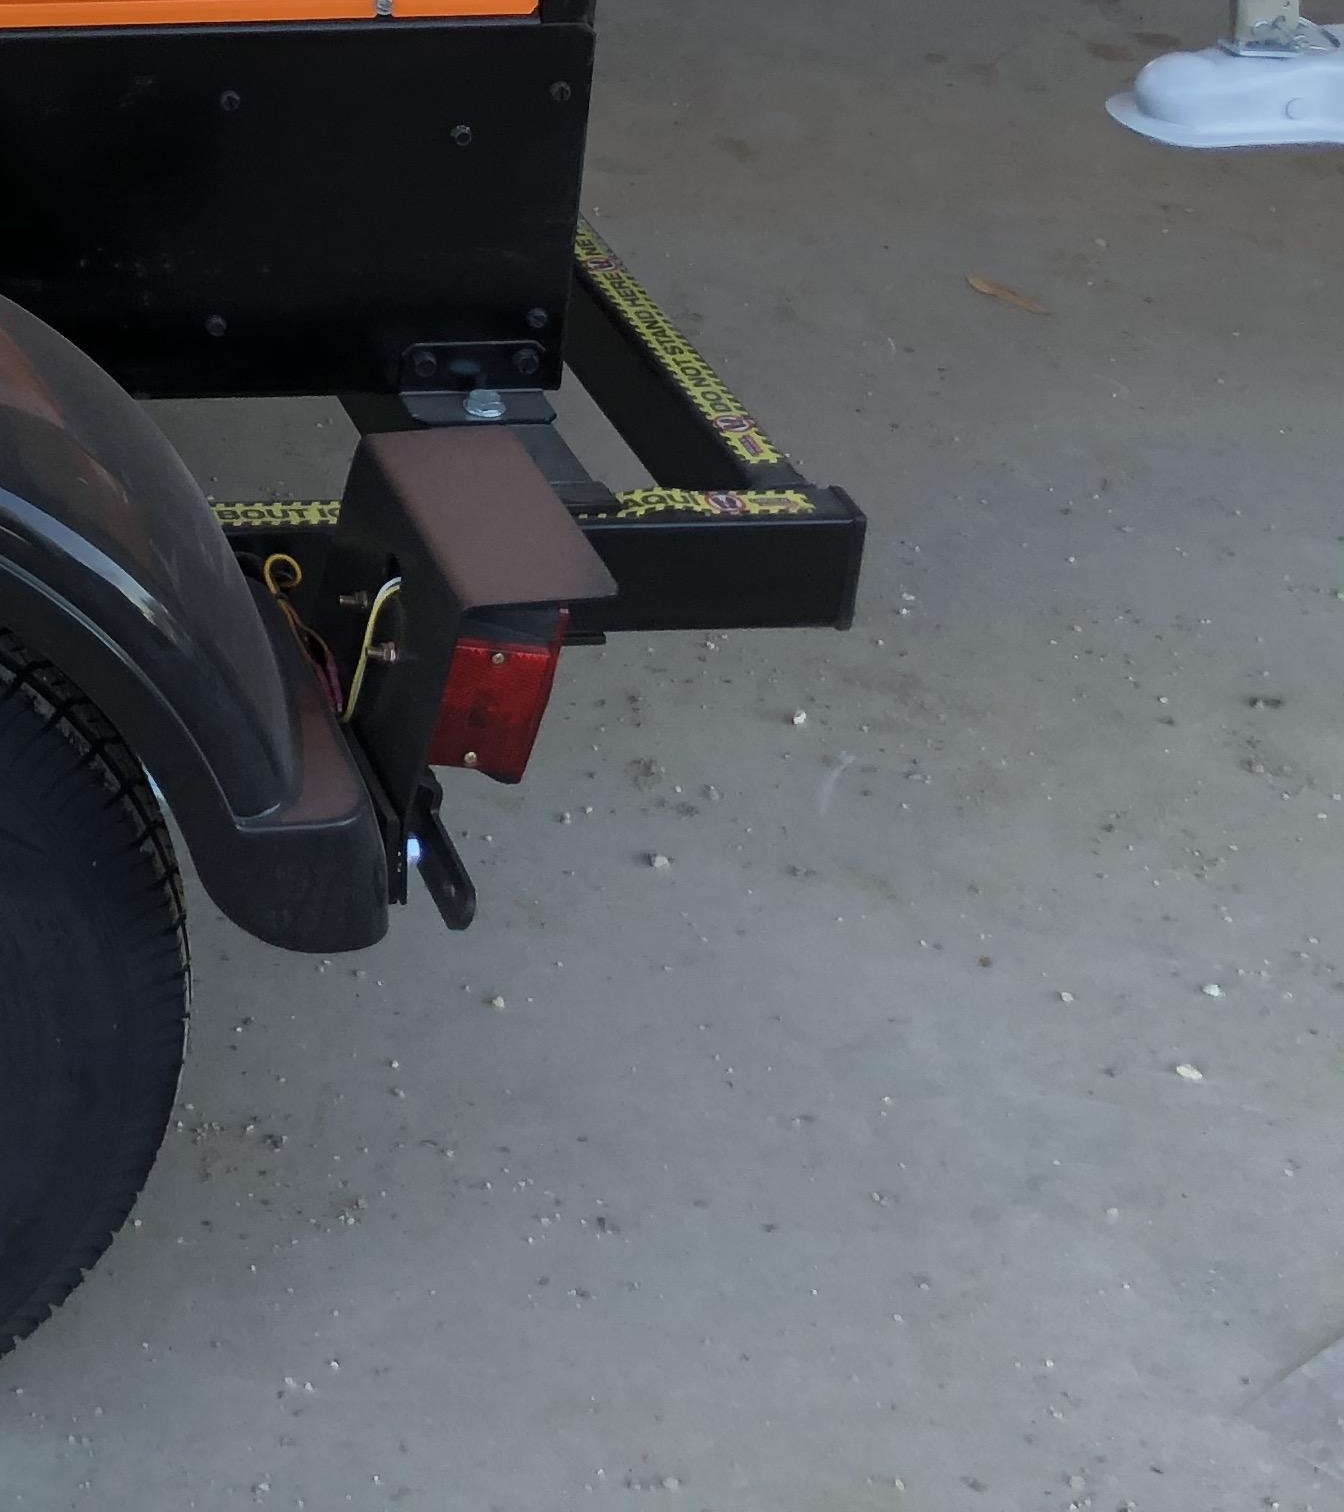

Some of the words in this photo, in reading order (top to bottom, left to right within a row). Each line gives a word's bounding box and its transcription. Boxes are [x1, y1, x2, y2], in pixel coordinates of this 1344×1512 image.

[602, 272, 647, 307] HERE
[635, 310, 684, 356] STAND
[672, 357, 711, 388] NOT
[701, 390, 733, 413] DO
